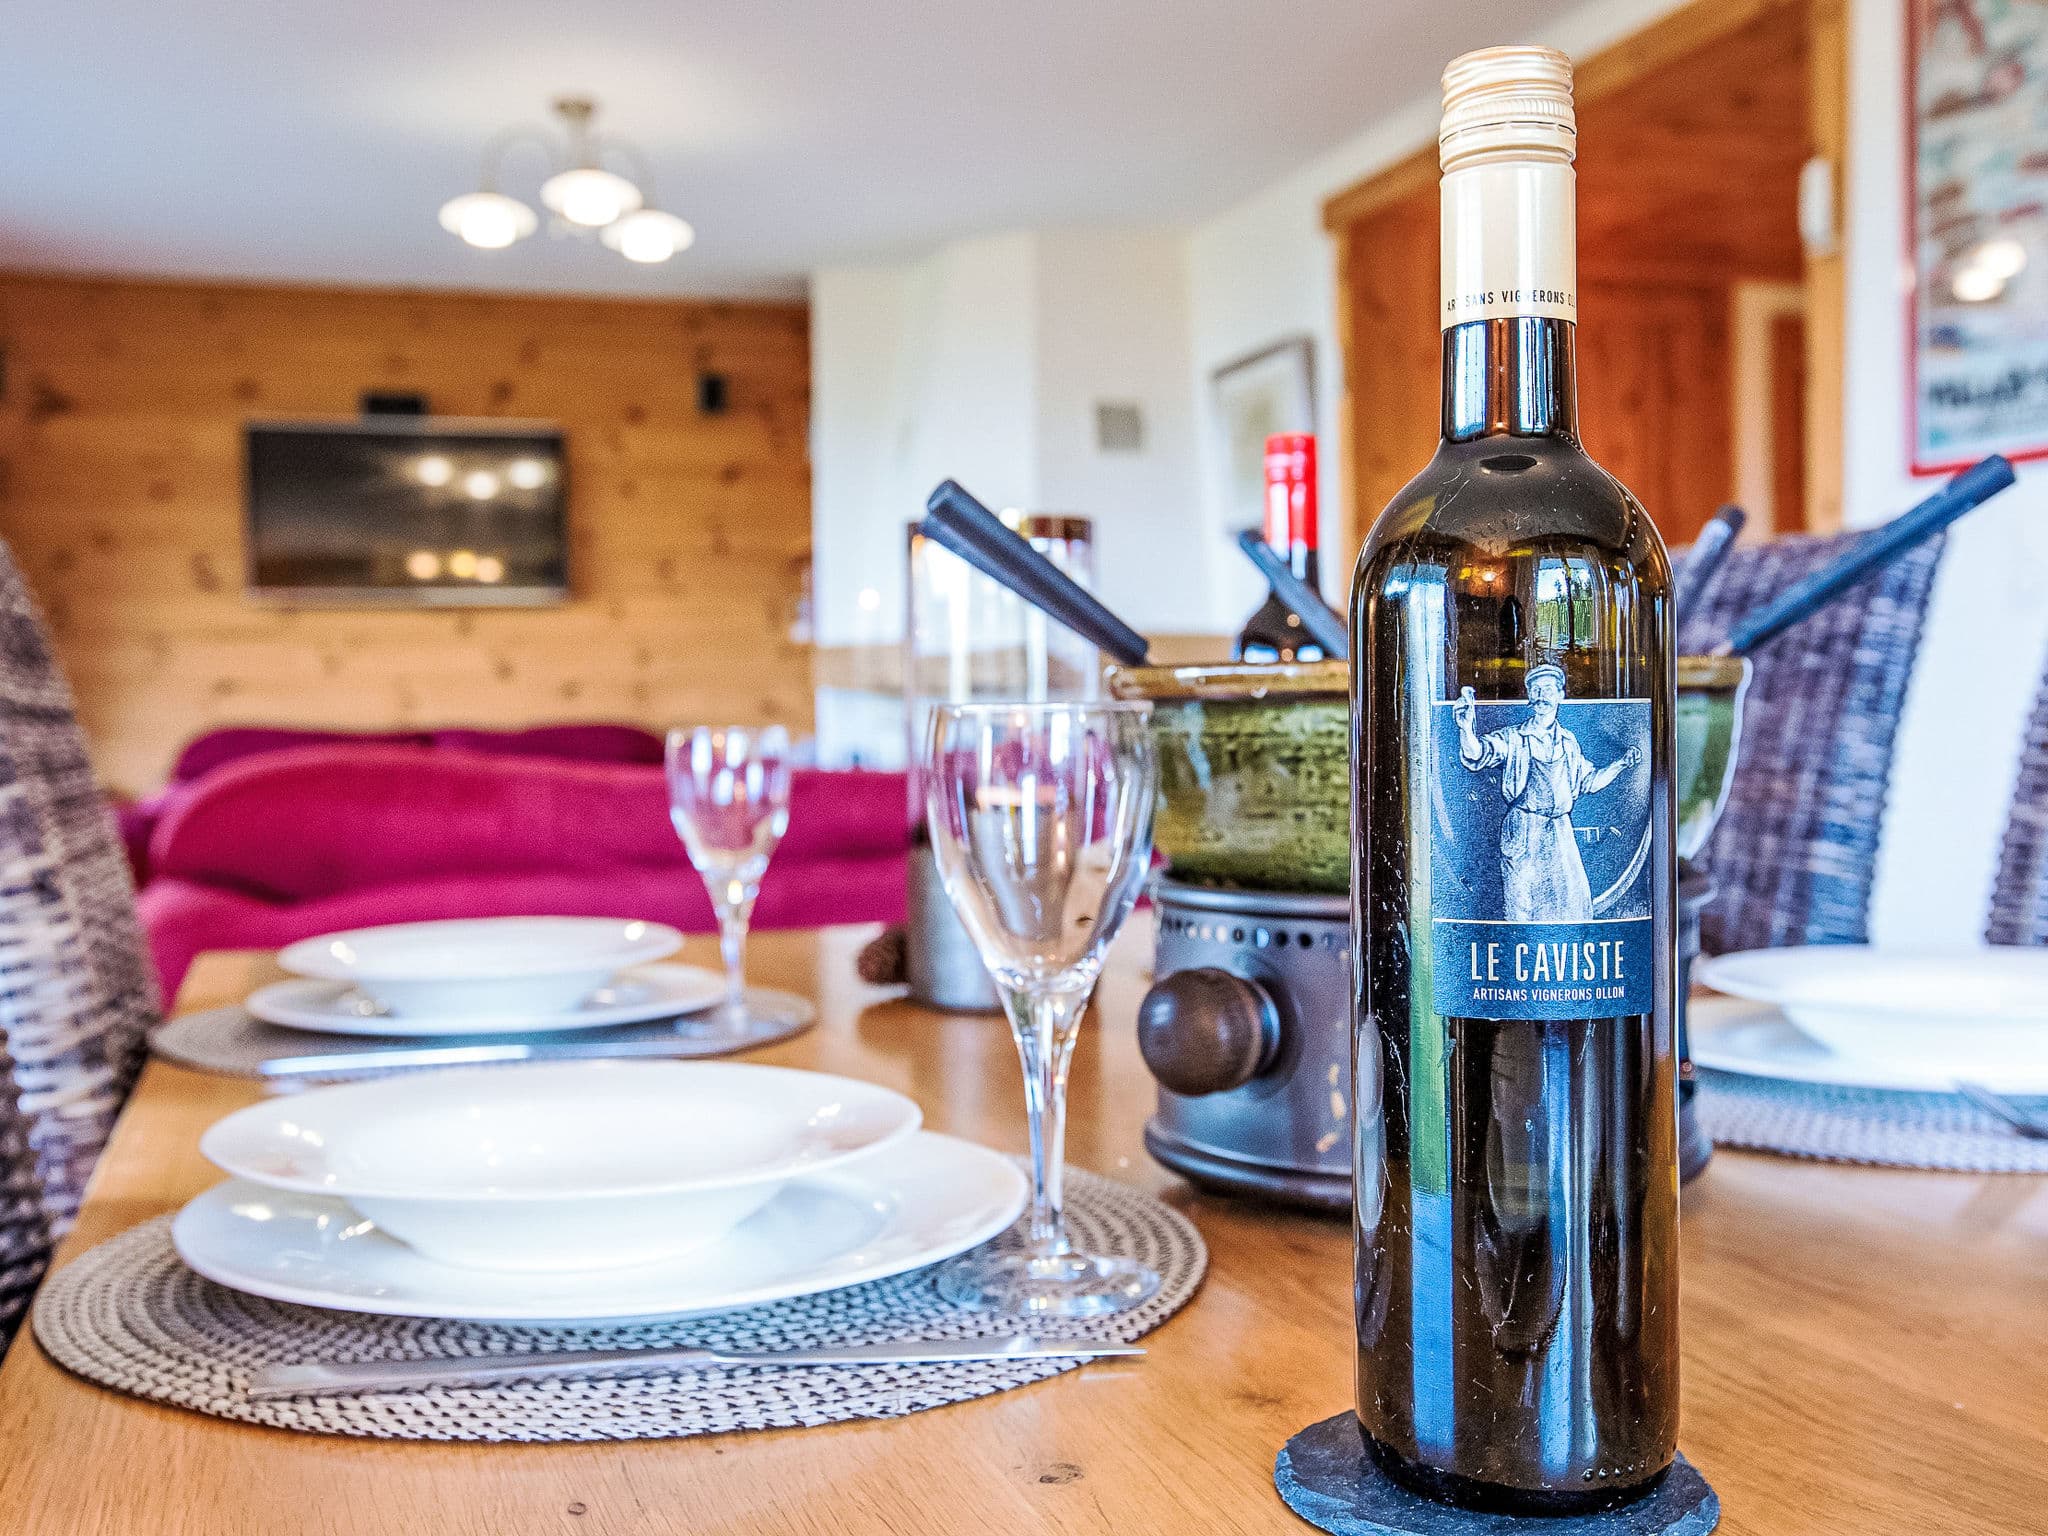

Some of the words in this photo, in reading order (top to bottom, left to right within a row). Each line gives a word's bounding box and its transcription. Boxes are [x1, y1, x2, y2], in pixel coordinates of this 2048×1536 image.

[1447, 291, 1494, 311] ARSANS
[1501, 289, 1565, 304] VIGERONS
[1471, 942, 1500, 981] LE
[1515, 940, 1624, 982] CAVISTE
[1473, 987, 1528, 1001] ARTISANS
[1531, 988, 1592, 1001] VIGNERONS
[1596, 985, 1625, 999] OLLON
